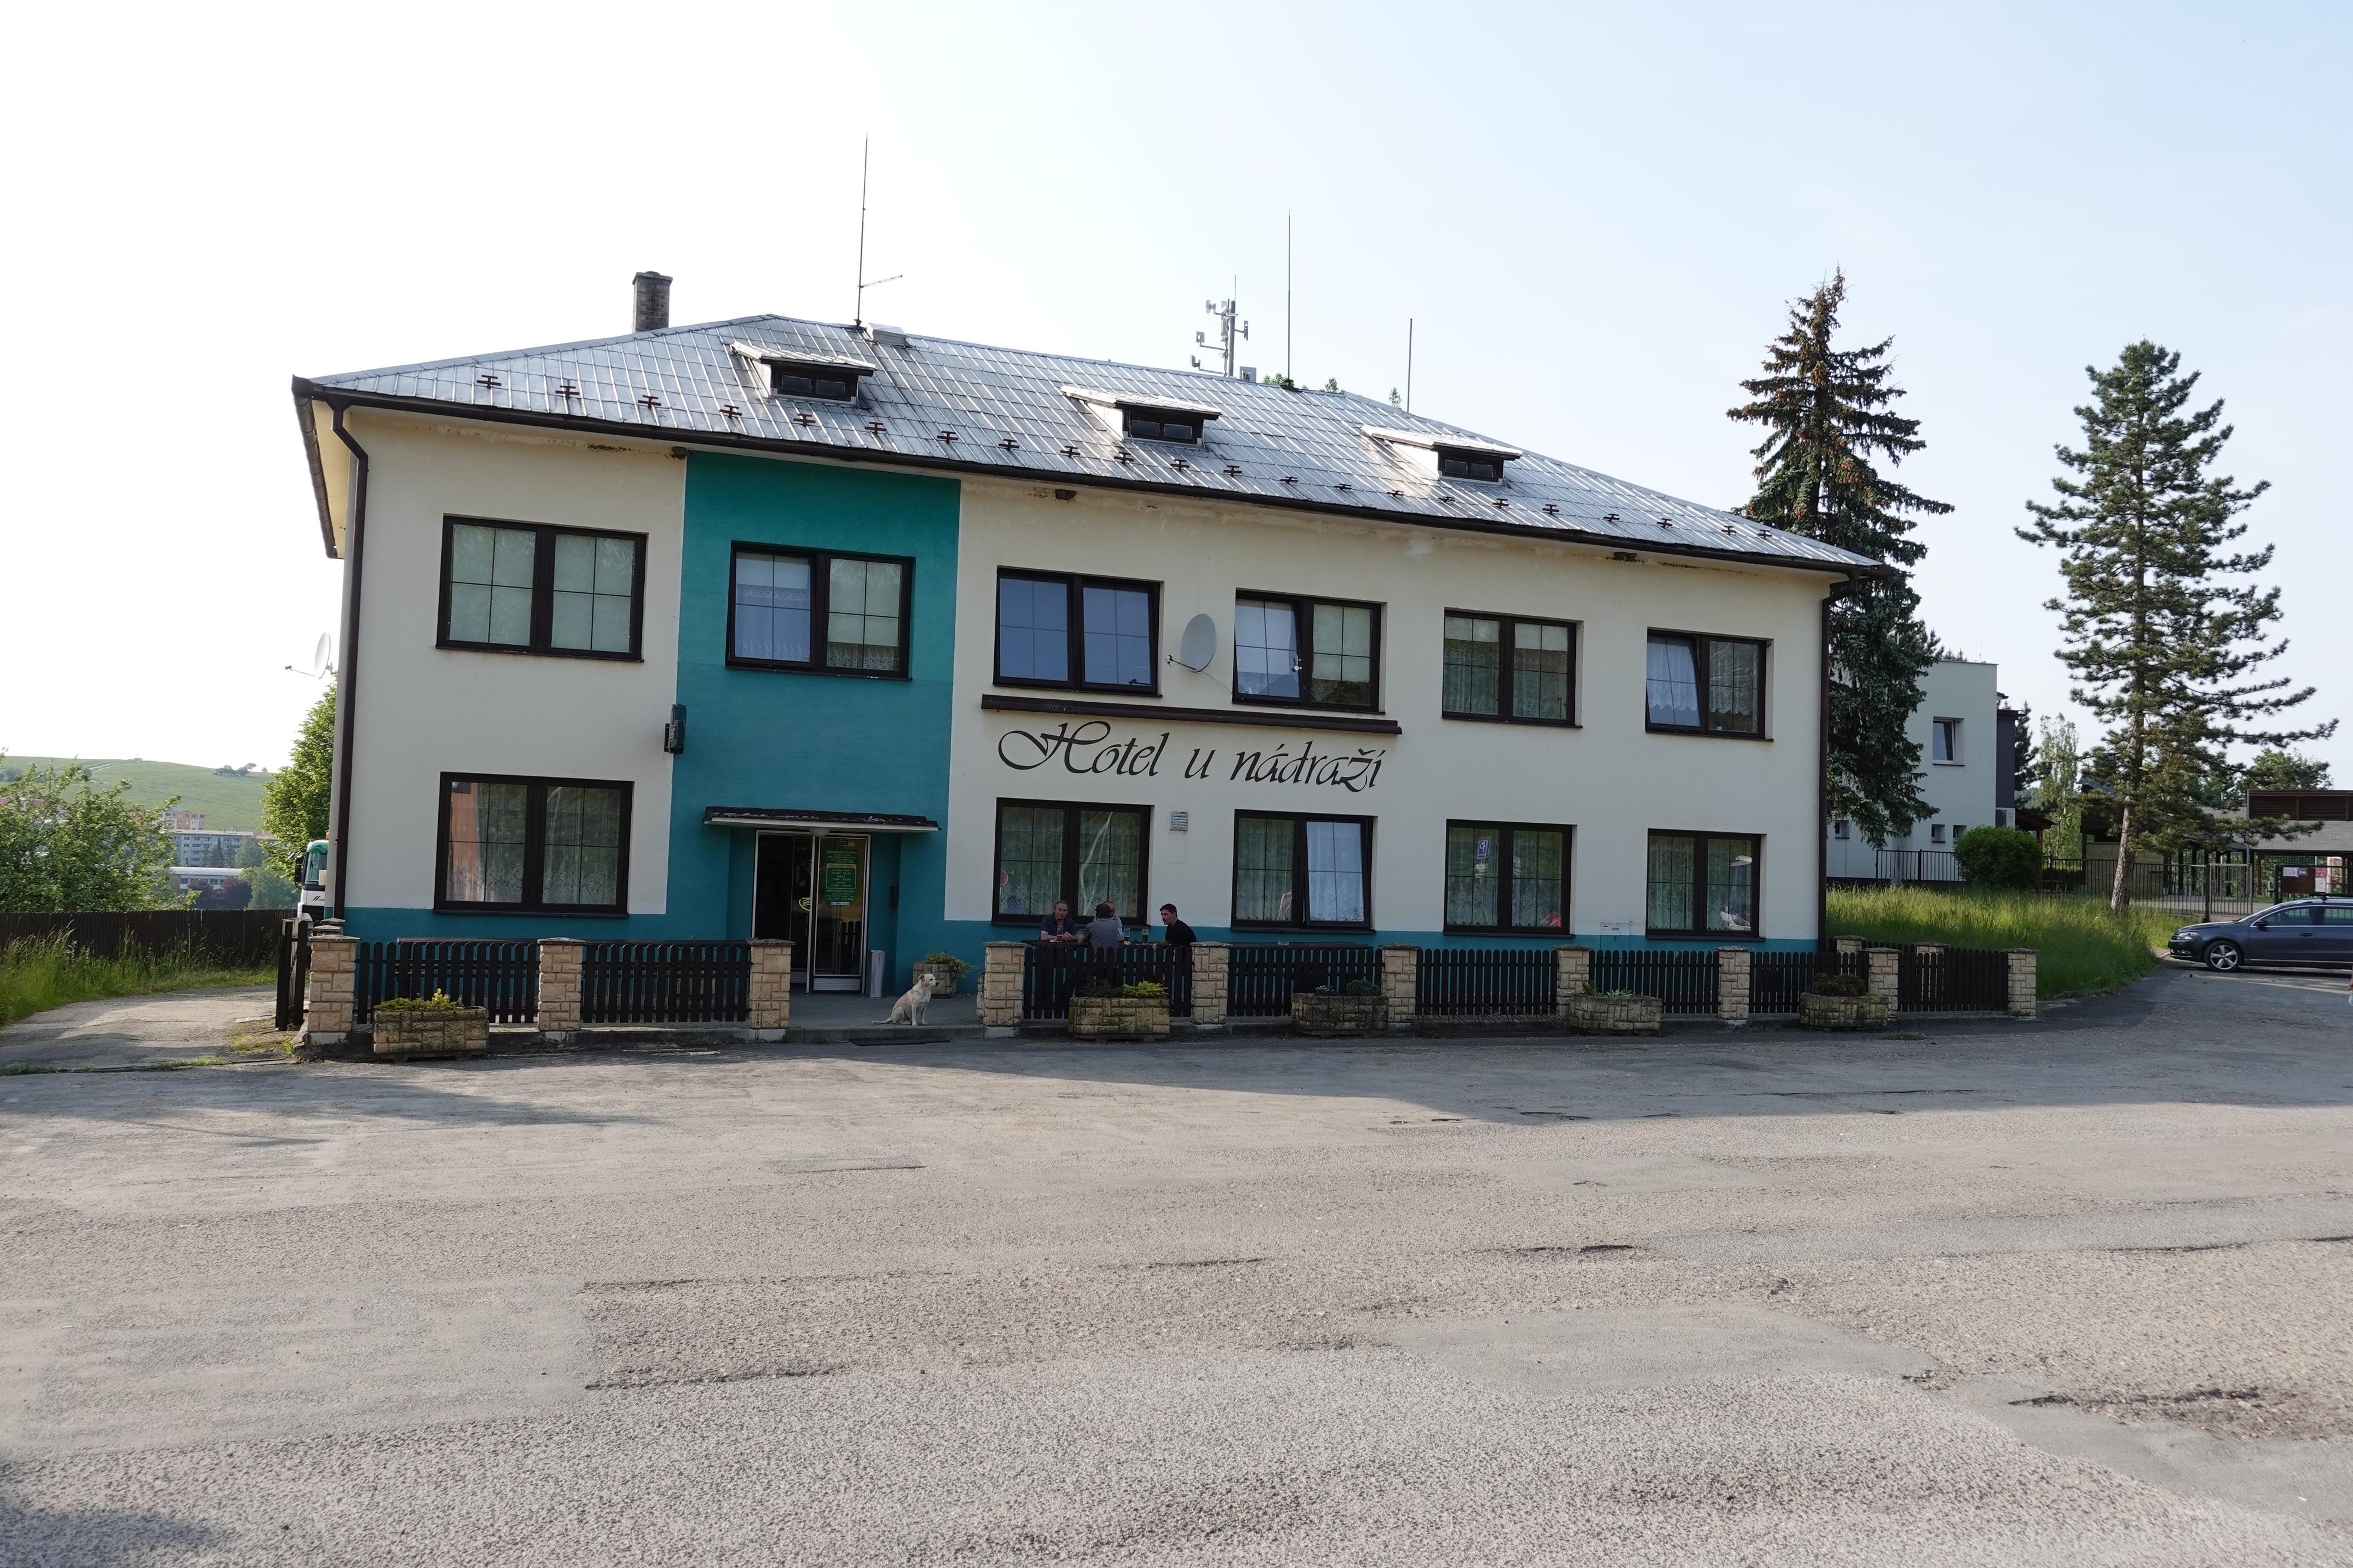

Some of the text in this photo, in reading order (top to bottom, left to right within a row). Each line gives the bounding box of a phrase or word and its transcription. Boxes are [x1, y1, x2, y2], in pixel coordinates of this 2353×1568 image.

[998, 720, 1387, 793] Hotel u nádraží
